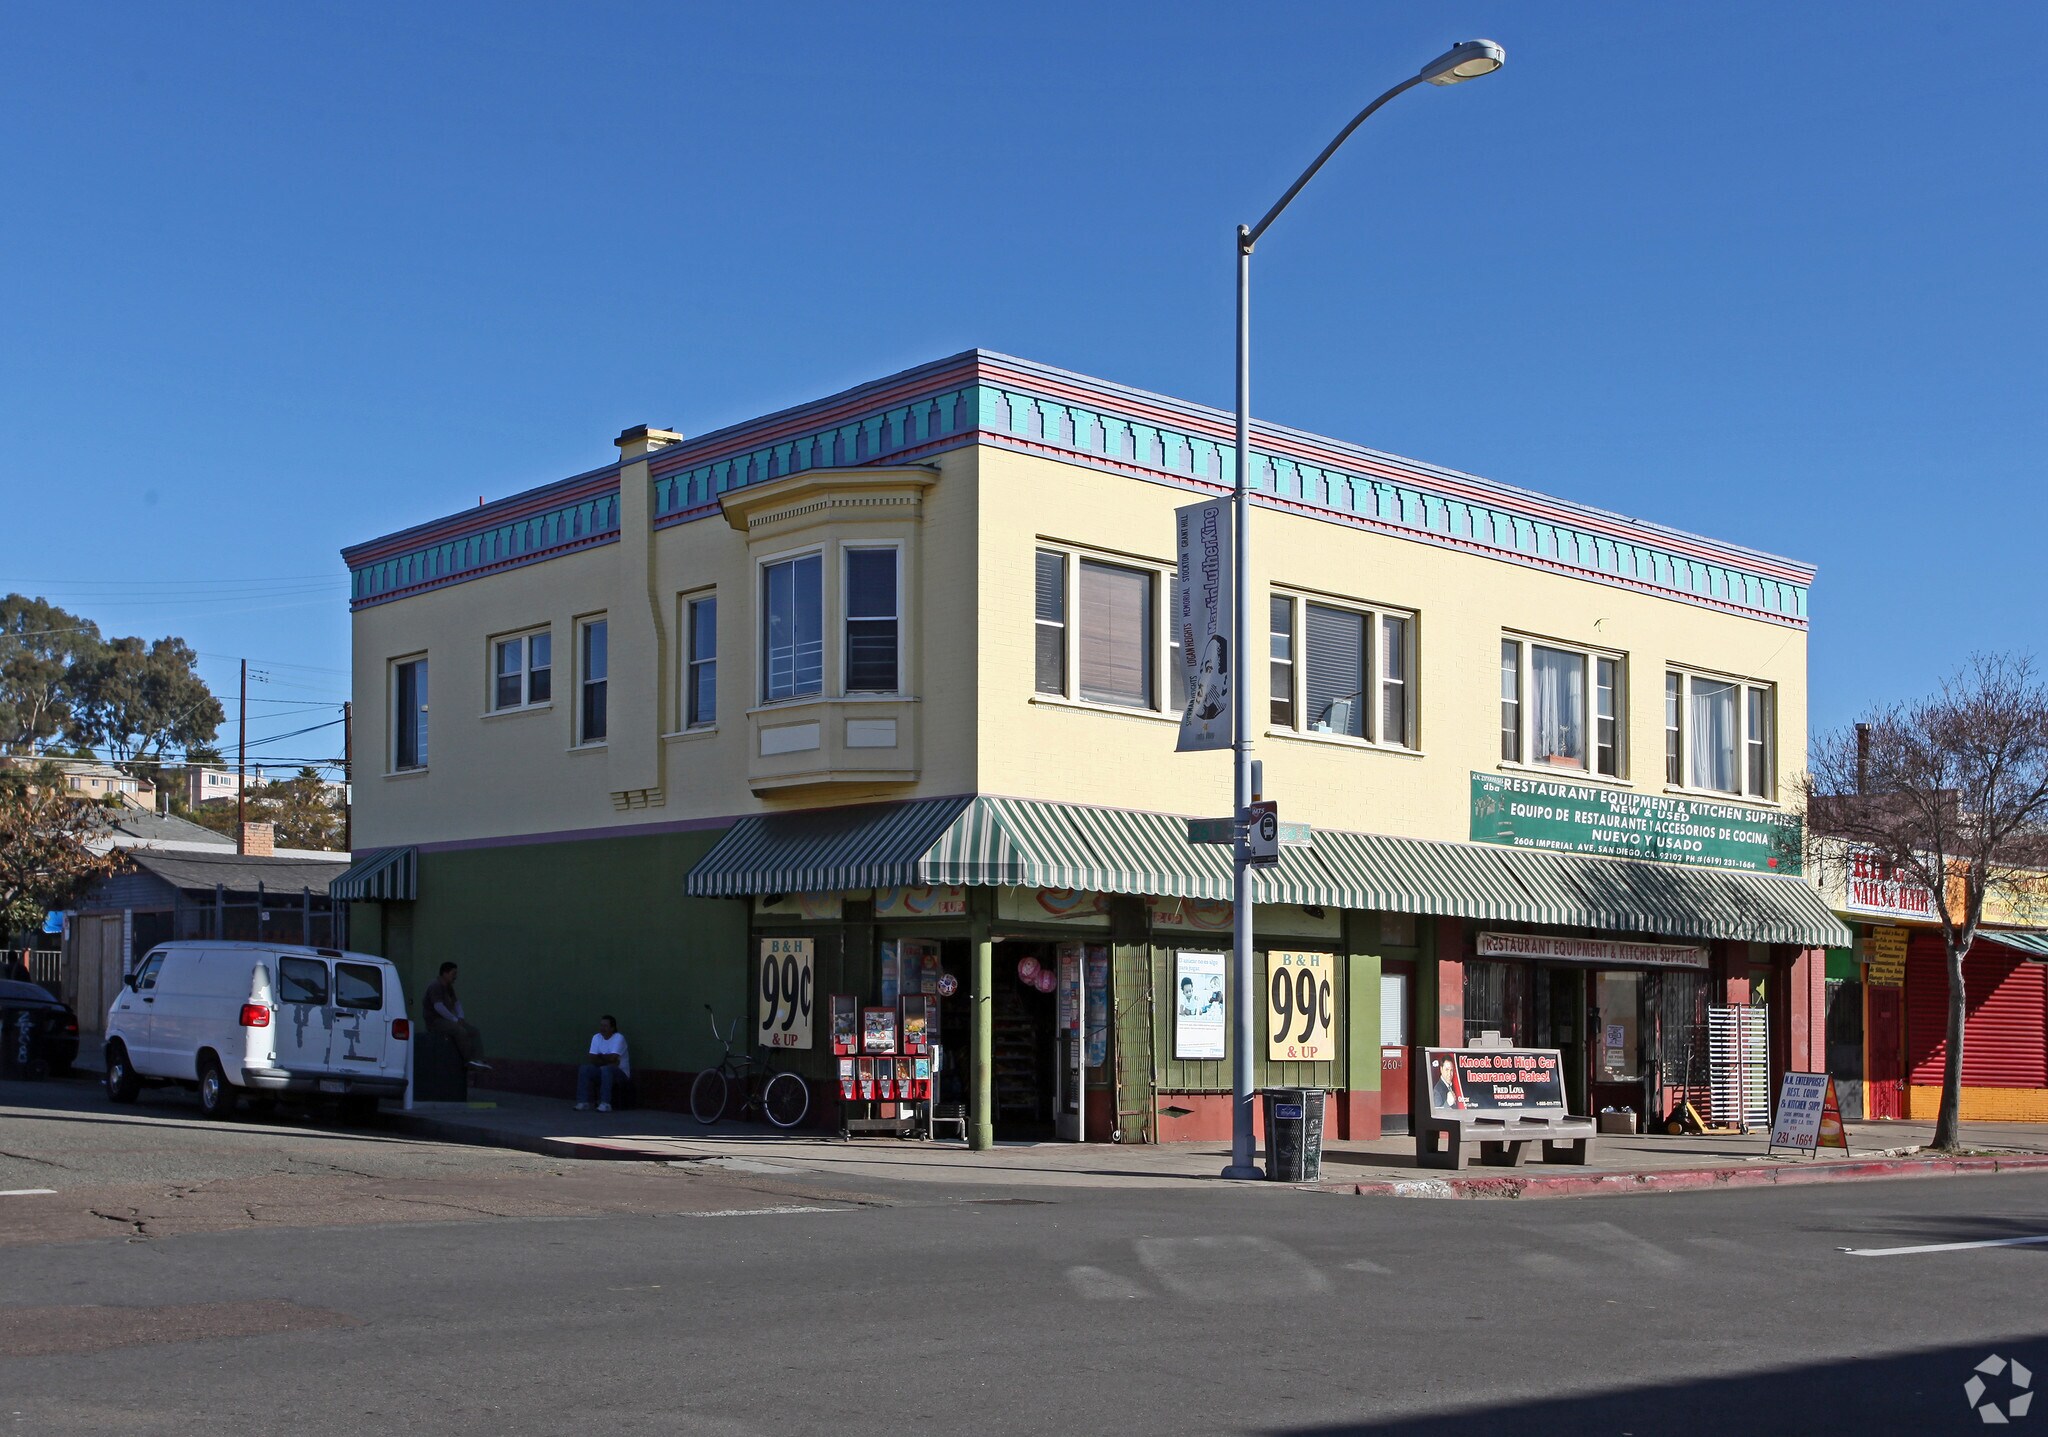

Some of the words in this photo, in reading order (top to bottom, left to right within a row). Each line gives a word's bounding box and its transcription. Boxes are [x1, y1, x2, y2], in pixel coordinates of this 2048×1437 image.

[1180, 514, 1189, 528] HILL
[1181, 528, 1190, 548] GRANT
[1181, 552, 1190, 583] STOCKTON
[1182, 587, 1192, 617] MEMORIAL
[1183, 622, 1195, 648] HEIGHTS
[1186, 647, 1197, 667] LOGAN
[1483, 782, 1501, 794] dba
[1503, 777, 1597, 802] RESTAURANT
[1600, 791, 1676, 812] EQUIPMENT
[1677, 800, 1686, 813] &
[1690, 802, 1743, 821] KITCHEN
[1610, 803, 1639, 817] NEW
[1644, 808, 1652, 818] &
[1657, 809, 1690, 823] USED
[1510, 803, 1553, 820] EQUIPO
[1555, 808, 1570, 822] DE
[1574, 811, 1647, 832] RESTAURANTE
[1655, 820, 1716, 839] ACCESORIOS
[1719, 828, 1731, 841] DE
[1732, 830, 1769, 846] COCINA
[1592, 830, 1640, 847] NUEVO
[1644, 835, 1654, 847] Y
[1656, 837, 1703, 853] USADO
[1514, 837, 1534, 848] 2606
[1536, 839, 1573, 851] IMPERIAL
[1598, 845, 1615, 855] SAN
[1659, 852, 1682, 863] 92102
[1685, 856, 1695, 864] PH
[1723, 859, 1756, 871] 231-1664
[1853, 881, 1887, 907] NAILS
[1899, 886, 1929, 913] HAIR
[772, 940, 780, 952] B
[782, 940, 791, 952] &
[794, 940, 803, 953] H
[1486, 937, 1551, 954] RESTAURANT
[1554, 942, 1608, 959] EQUIPMENT
[1610, 945, 1617, 959] &
[1619, 946, 1657, 962] KITCHEN
[1659, 948, 1698, 965] SUPPLIES
[1282, 953, 1292, 966] B
[1295, 954, 1306, 967] &
[1310, 955, 1321, 967] H
[762, 953, 811, 1031] 99¢
[1271, 966, 1331, 1044] 99¢
[772, 1032, 781, 1046] &
[783, 1033, 799, 1047] UP
[1287, 1045, 1298, 1059] &
[1301, 1046, 1319, 1059] UP
[1459, 1055, 1493, 1070] Knock
[1493, 1056, 1512, 1070] Out
[1514, 1056, 1537, 1072] High
[1538, 1057, 1556, 1070] Car
[1466, 1070, 1517, 1083] Insurance
[1518, 1070, 1551, 1083] Rates!
[1795, 1077, 1825, 1086] ENTERPRISES
[1786, 1088, 1800, 1097] REST.
[1803, 1089, 1819, 1098] EQUIP.
[1781, 1099, 1786, 1108] &
[1787, 1100, 1807, 1109] KITCHEN
